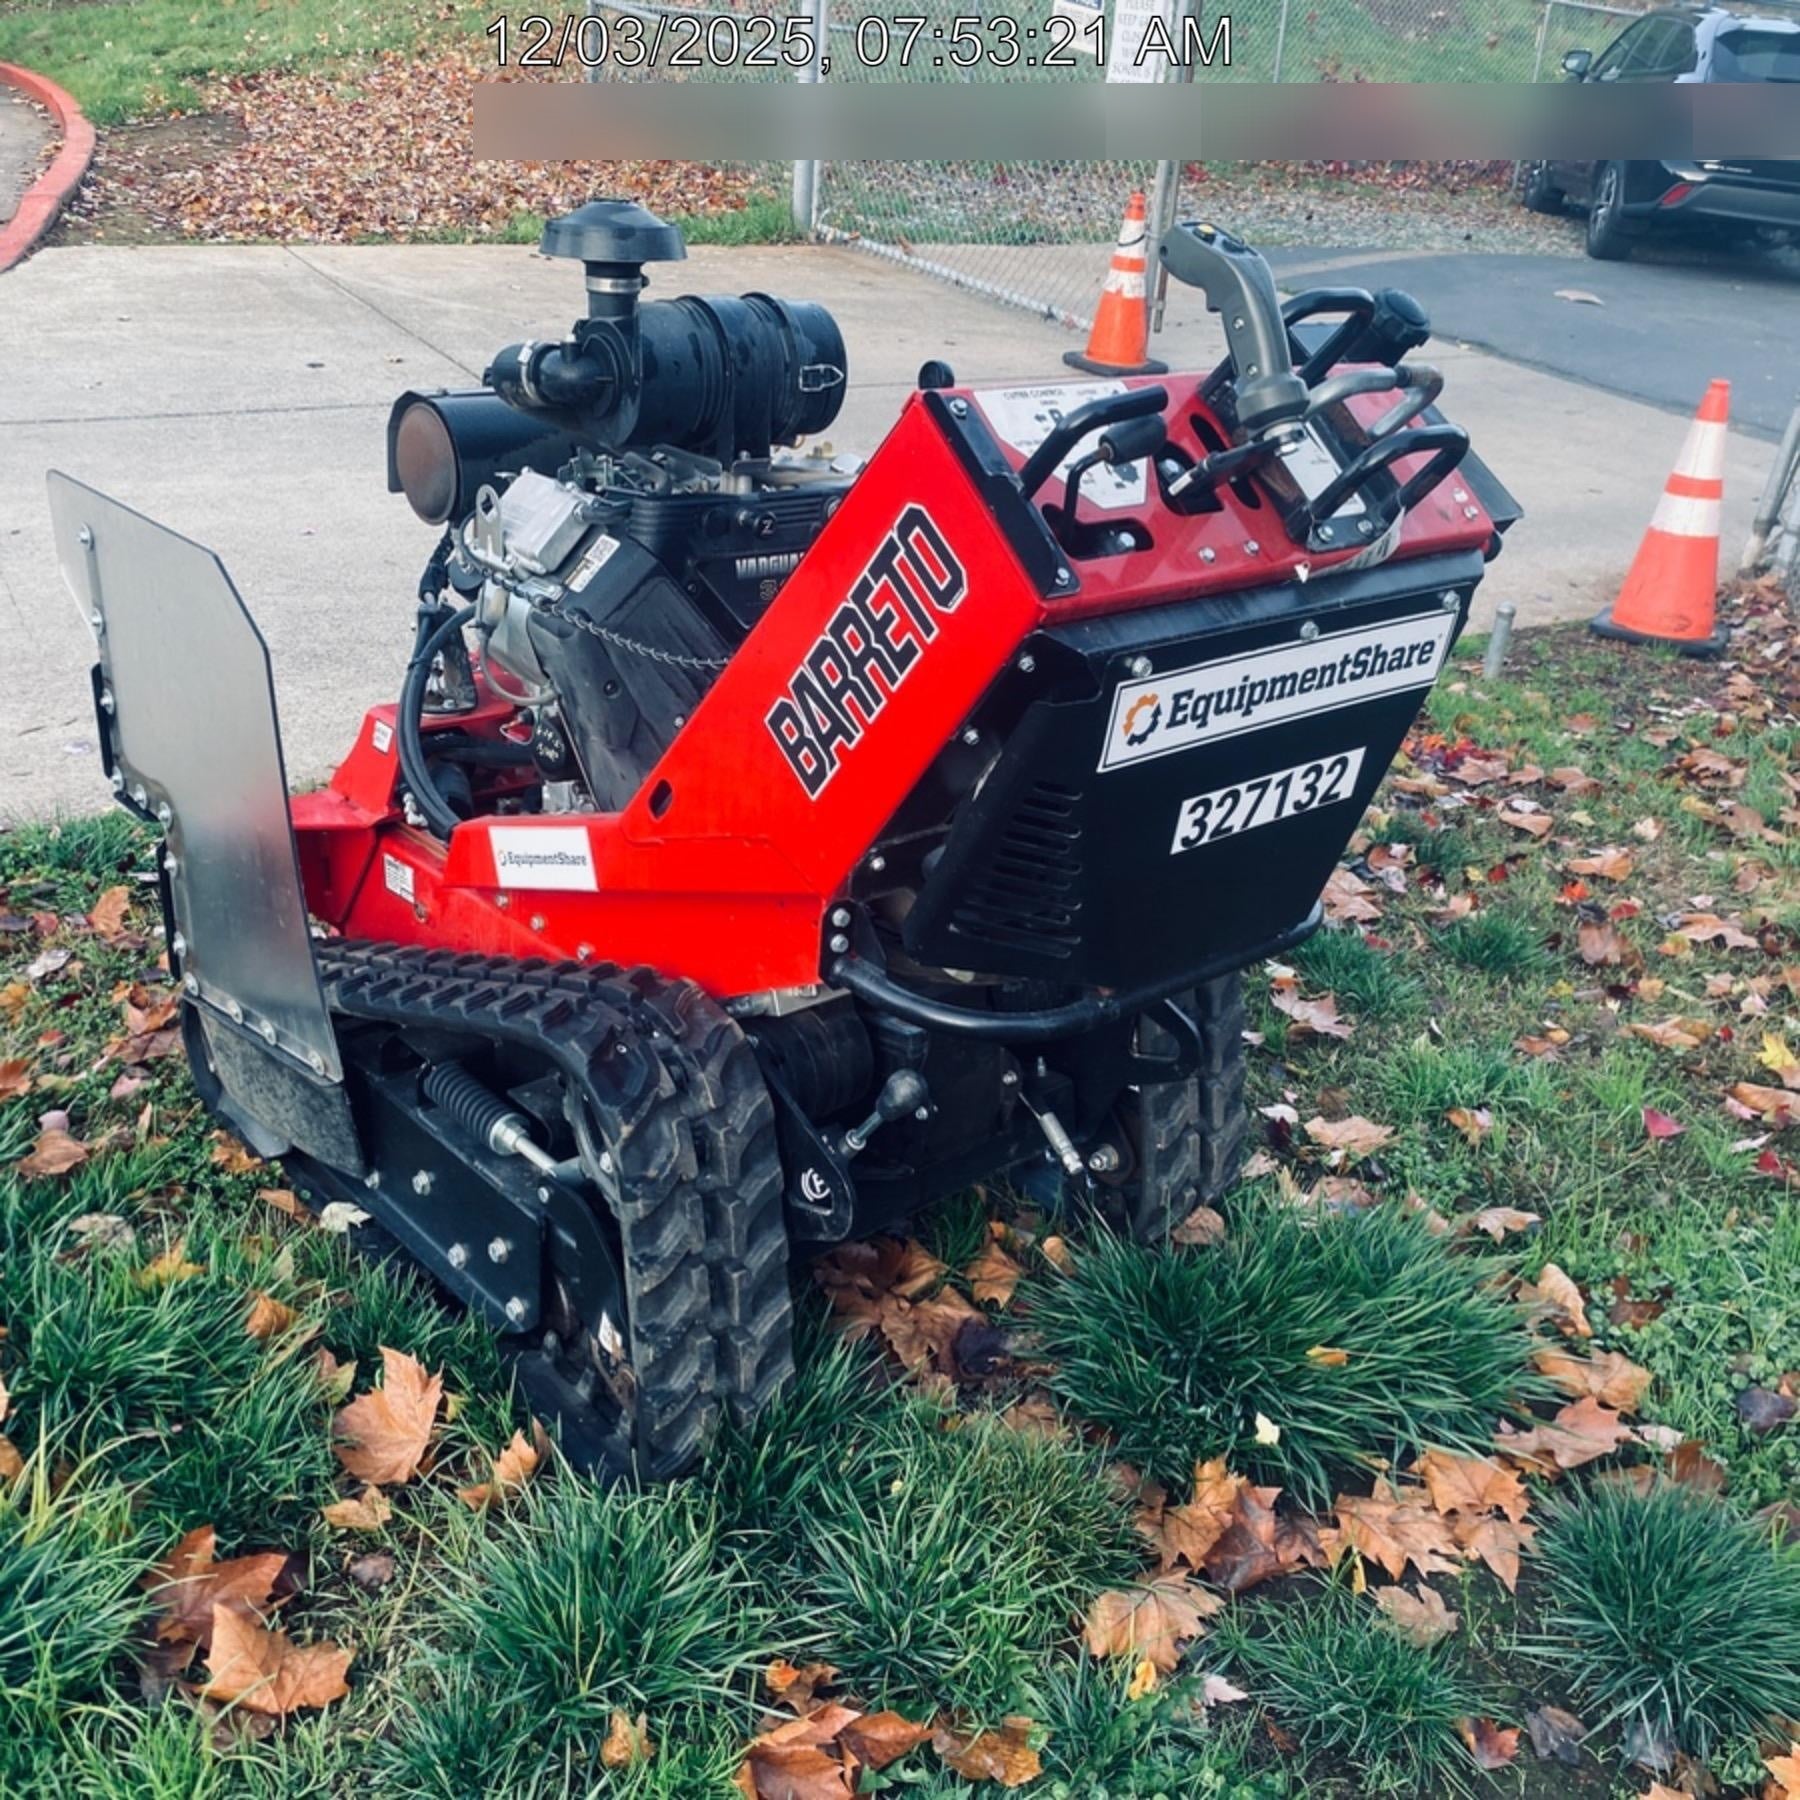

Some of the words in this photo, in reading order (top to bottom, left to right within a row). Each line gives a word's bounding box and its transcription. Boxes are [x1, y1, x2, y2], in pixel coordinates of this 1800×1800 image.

[764, 502, 968, 801] BARRETO
[1165, 639, 1437, 730] EquipmentShare
[1180, 754, 1350, 850] 327132
[507, 851, 587, 869] EquipmentShare
